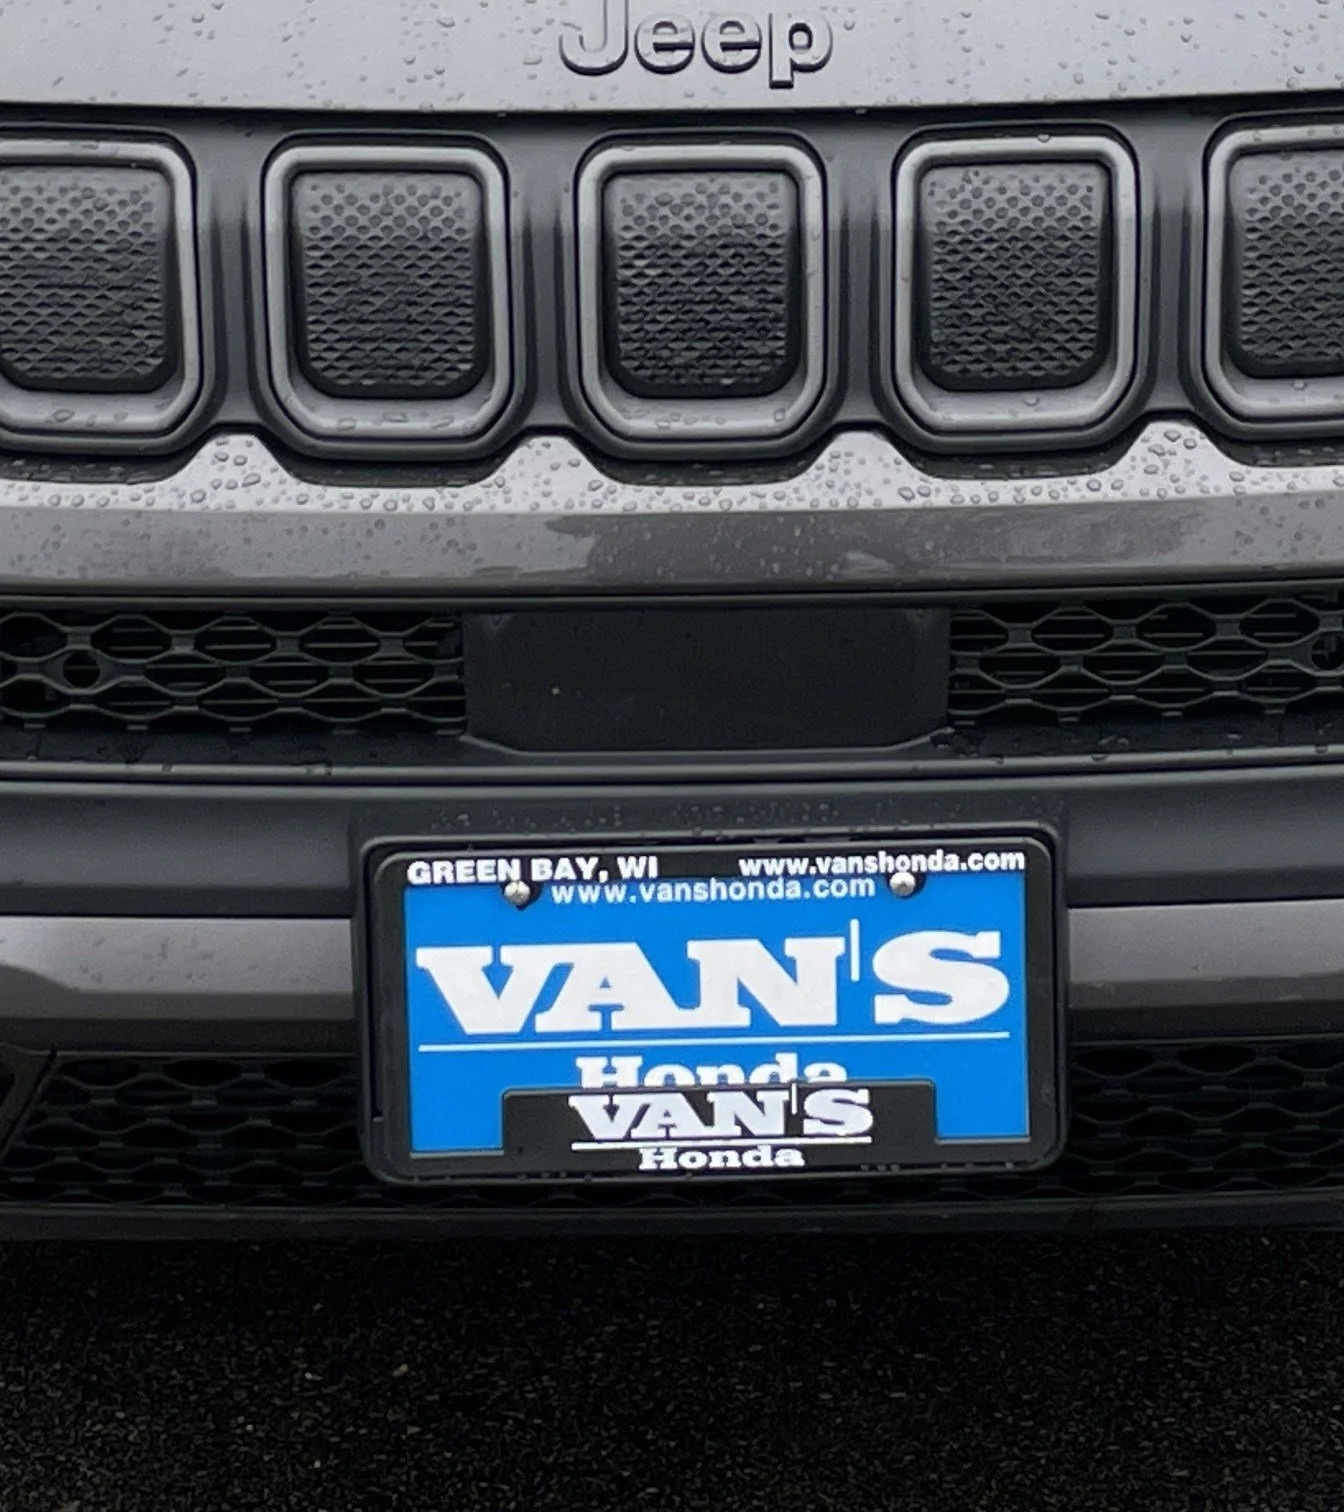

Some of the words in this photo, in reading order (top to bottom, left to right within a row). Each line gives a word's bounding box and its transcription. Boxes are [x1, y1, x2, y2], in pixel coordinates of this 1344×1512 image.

[406, 858, 521, 885] GREEN
[530, 856, 609, 883] BAY,
[617, 855, 659, 879] WI
[738, 849, 1026, 877] www.vanshonda.com
[551, 876, 876, 904] www.vanshonda.com
[415, 918, 1010, 1035] VAN'S
[576, 1051, 848, 1088] Honda
[567, 1082, 874, 1141] VAN'S
[638, 1144, 806, 1170] Honda
